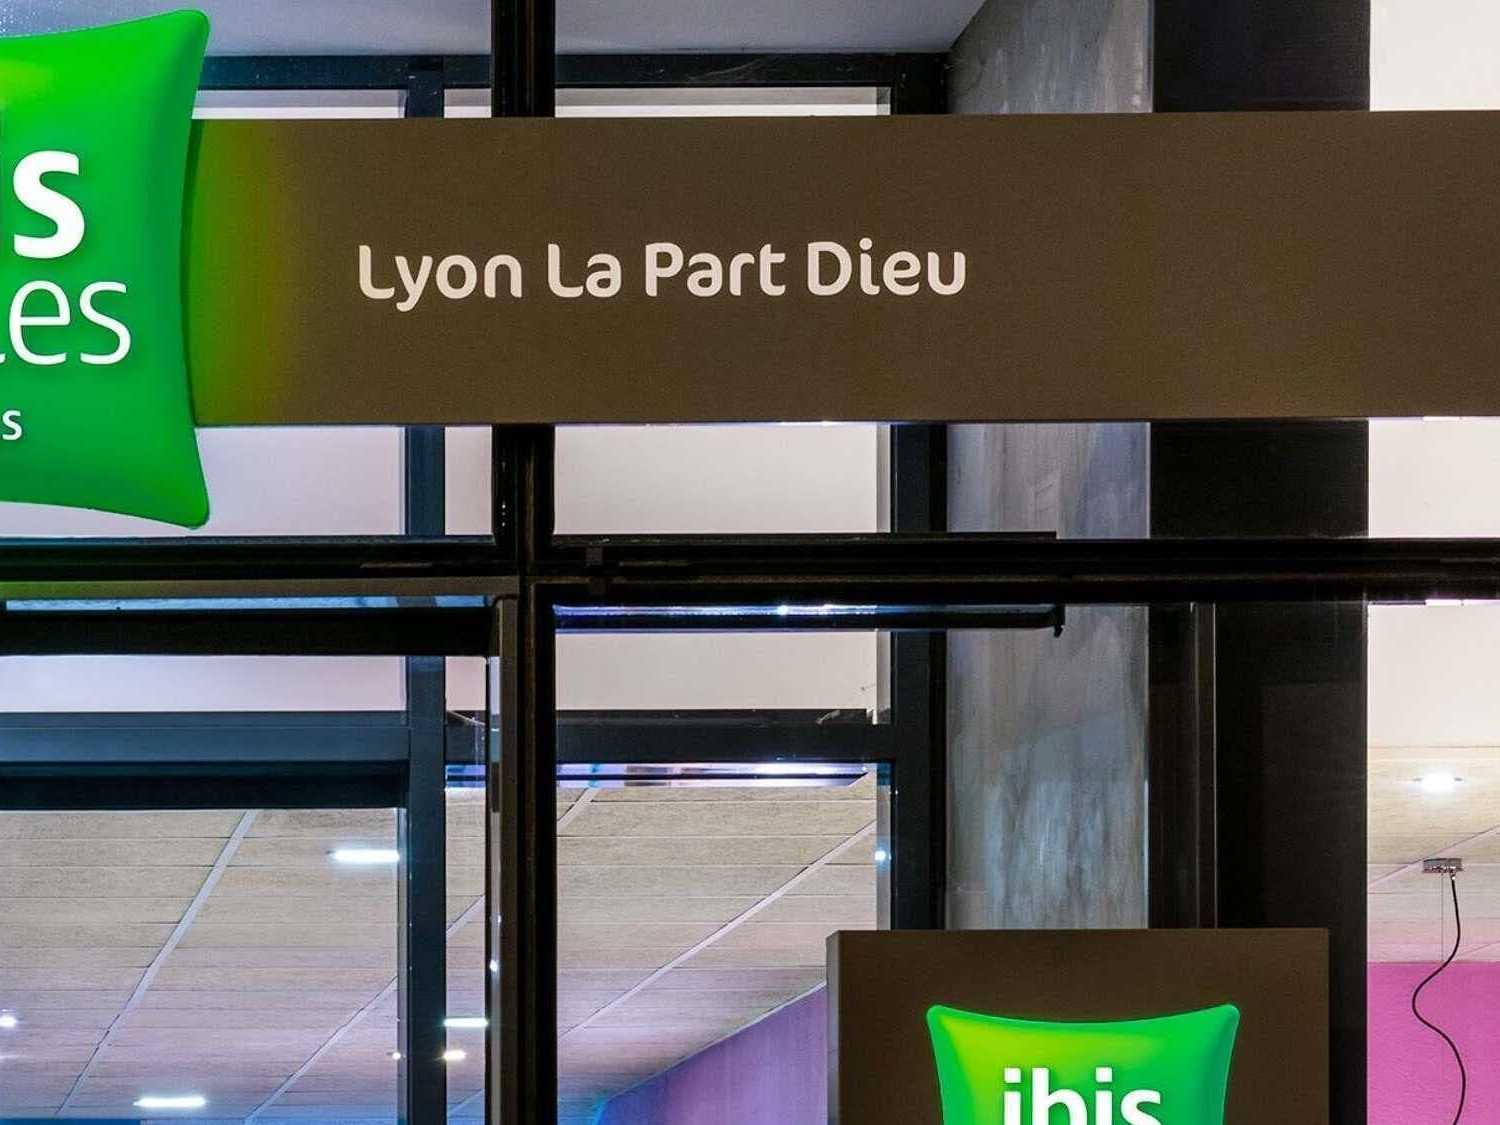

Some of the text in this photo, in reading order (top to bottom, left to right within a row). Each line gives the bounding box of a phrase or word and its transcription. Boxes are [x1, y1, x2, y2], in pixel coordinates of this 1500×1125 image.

[358, 237, 967, 312] Lyon La Part Dieu
